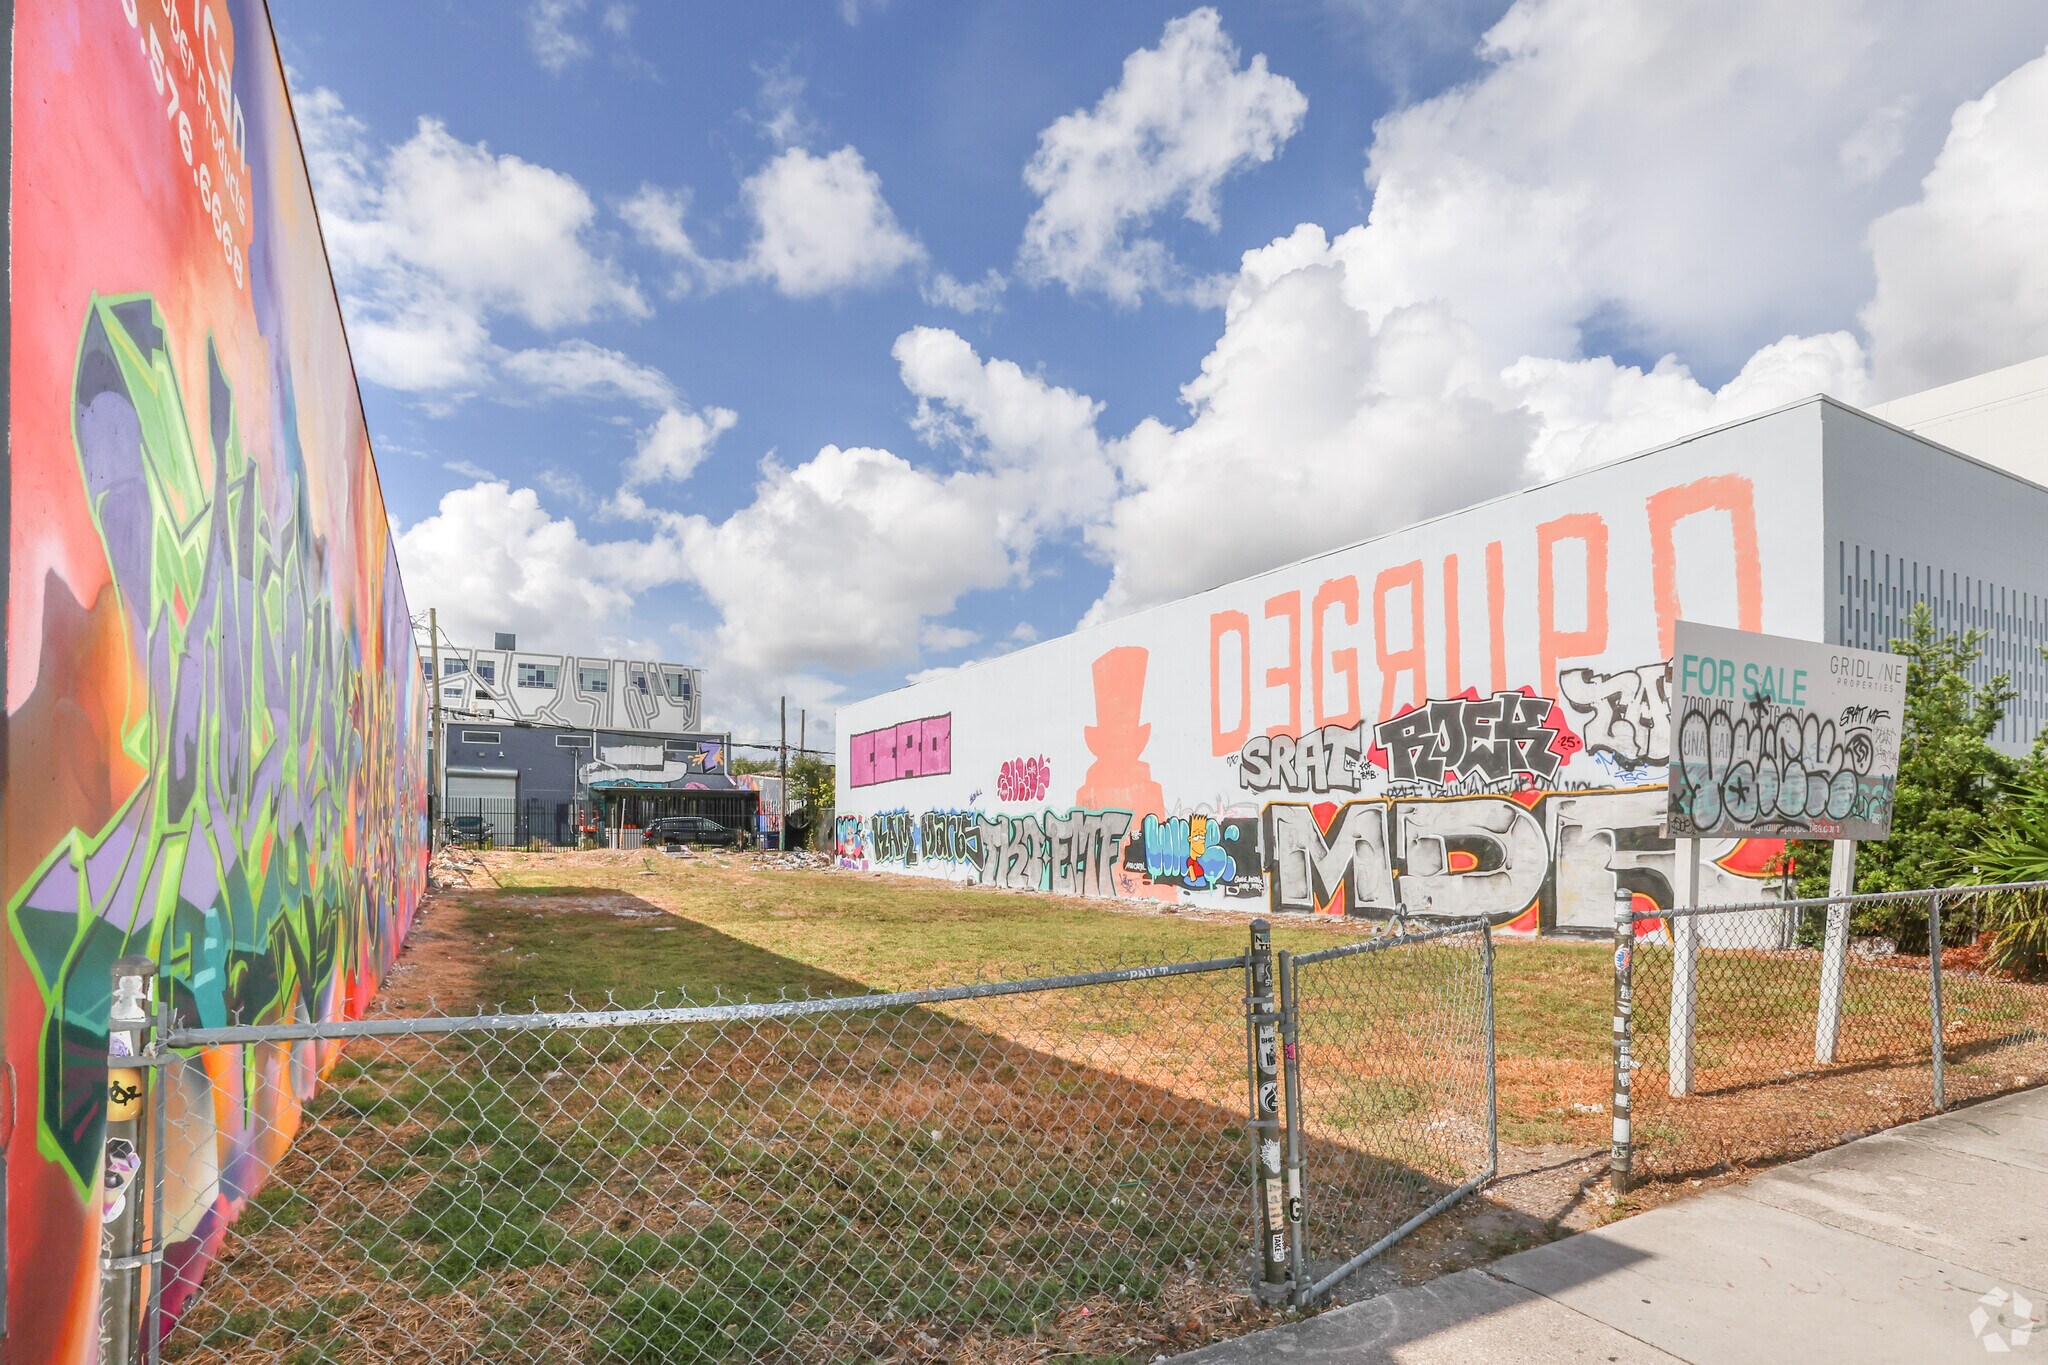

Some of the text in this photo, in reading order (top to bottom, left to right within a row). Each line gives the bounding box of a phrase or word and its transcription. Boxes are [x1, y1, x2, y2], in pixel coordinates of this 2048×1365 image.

[1681, 654, 1808, 706] FOR SALE
[1836, 677, 1894, 693] PROPERTIES
